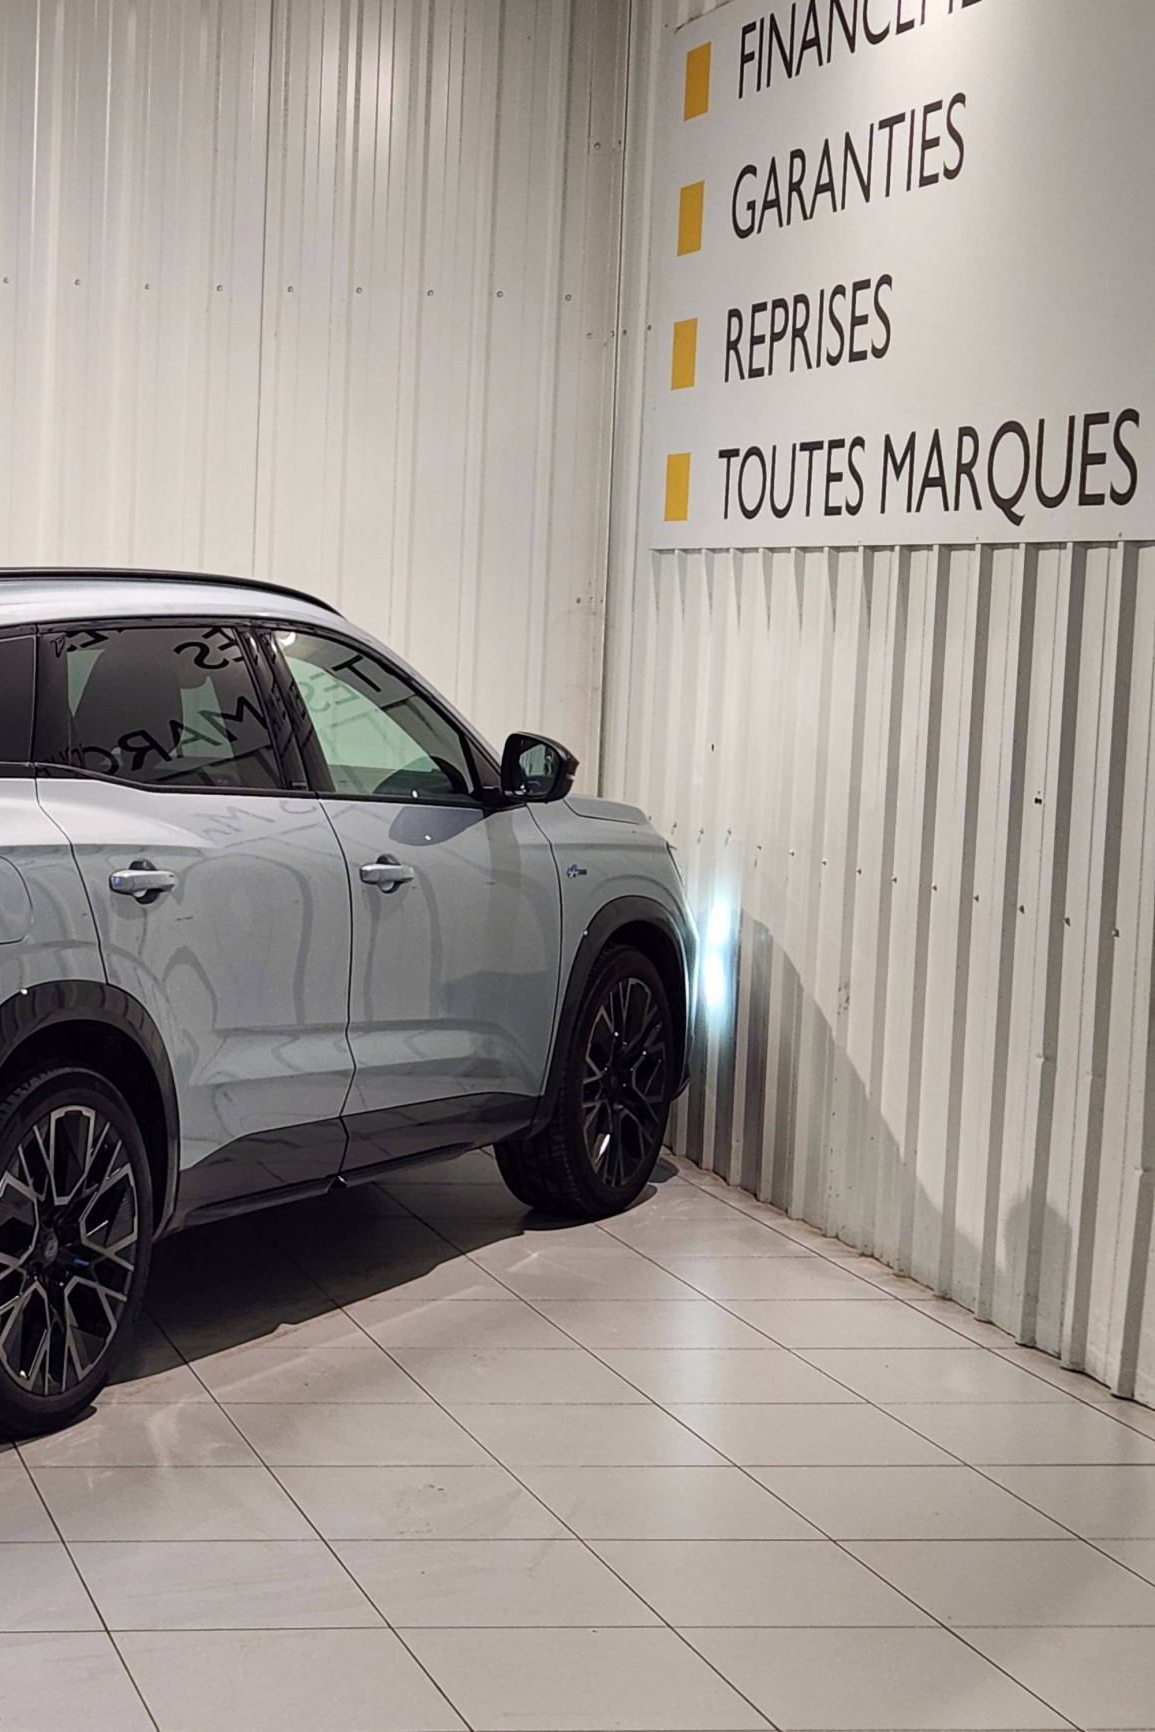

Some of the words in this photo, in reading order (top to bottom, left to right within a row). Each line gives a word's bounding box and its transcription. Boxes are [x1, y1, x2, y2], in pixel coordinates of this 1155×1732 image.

[731, 92, 966, 240] GARANTIES
[724, 273, 893, 383] REPRISES
[718, 436, 865, 520] TOUTES
[880, 408, 1140, 526] MARQUES
